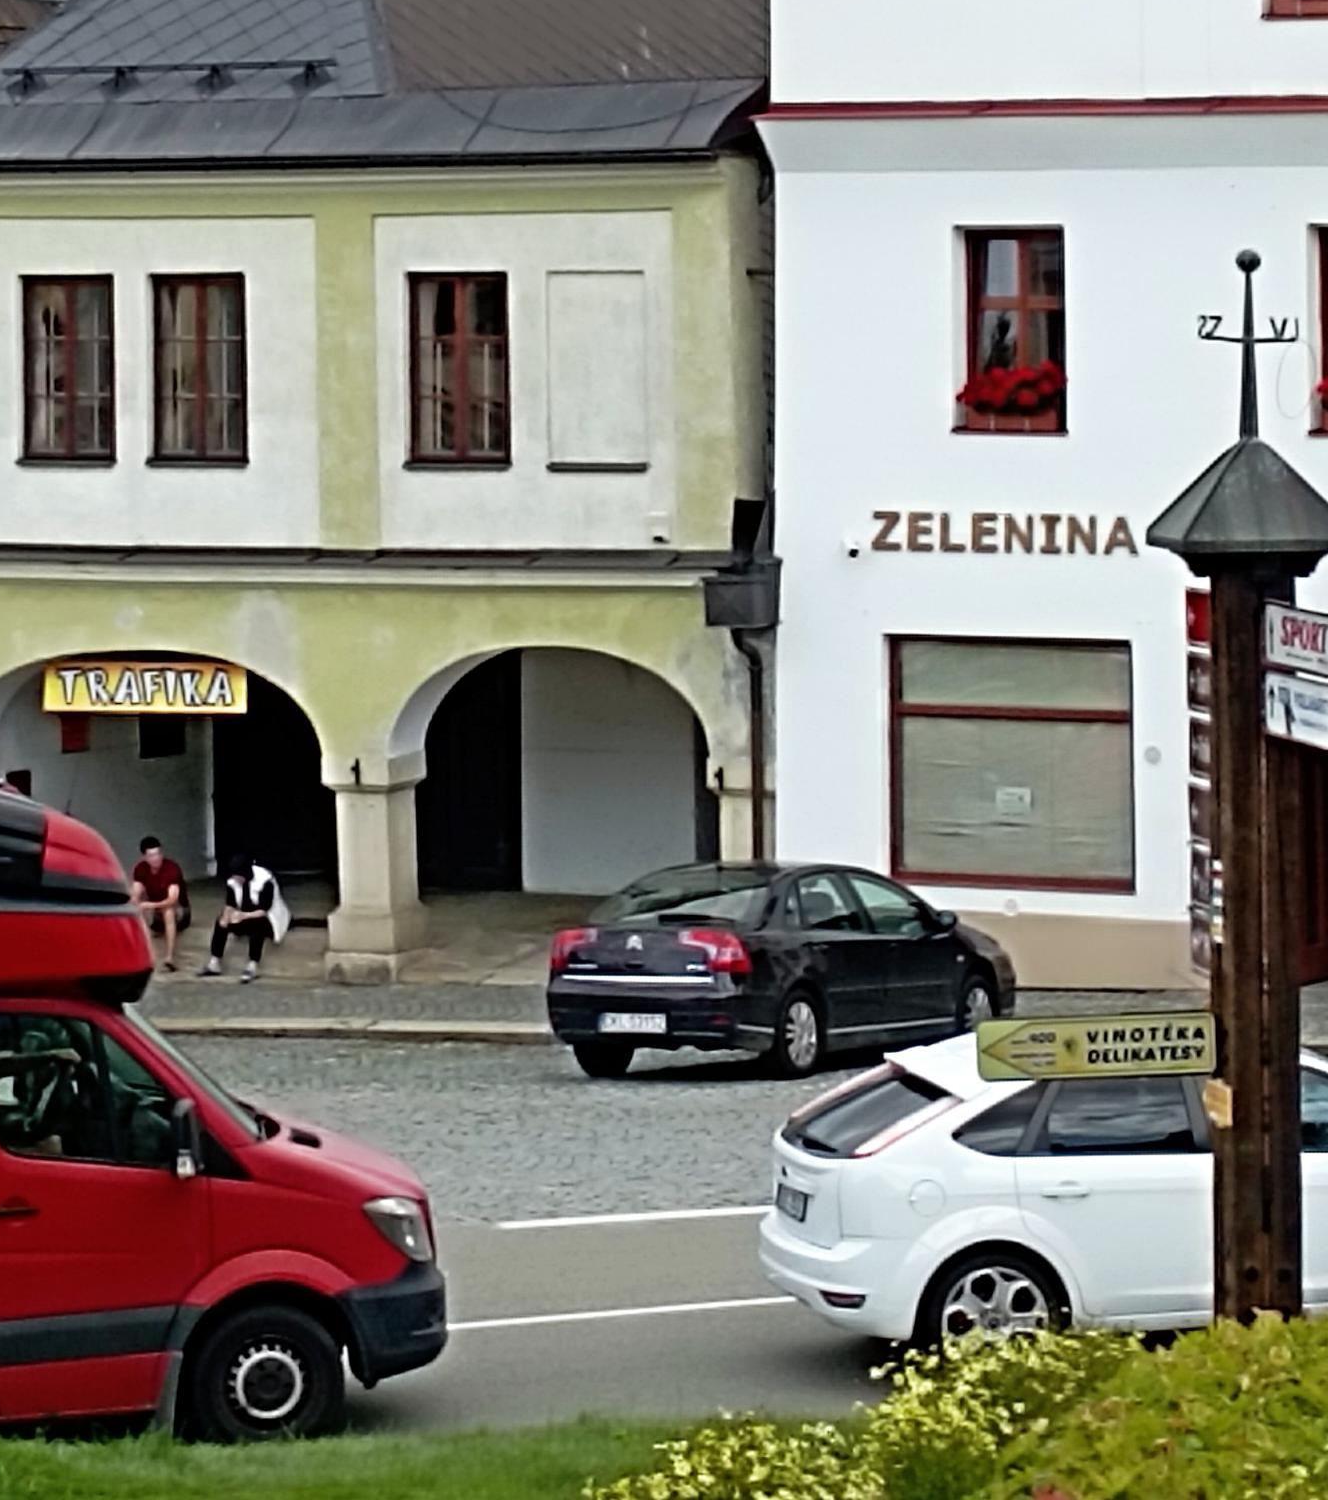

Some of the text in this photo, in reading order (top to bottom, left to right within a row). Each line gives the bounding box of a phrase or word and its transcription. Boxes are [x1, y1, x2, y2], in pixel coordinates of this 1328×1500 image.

[871, 510, 1139, 557] ZELENINA
[56, 667, 236, 708] TRAFIKA
[1086, 1021, 1205, 1044] VINOTÉKA
[1087, 1044, 1205, 1065] DELIKATESY
